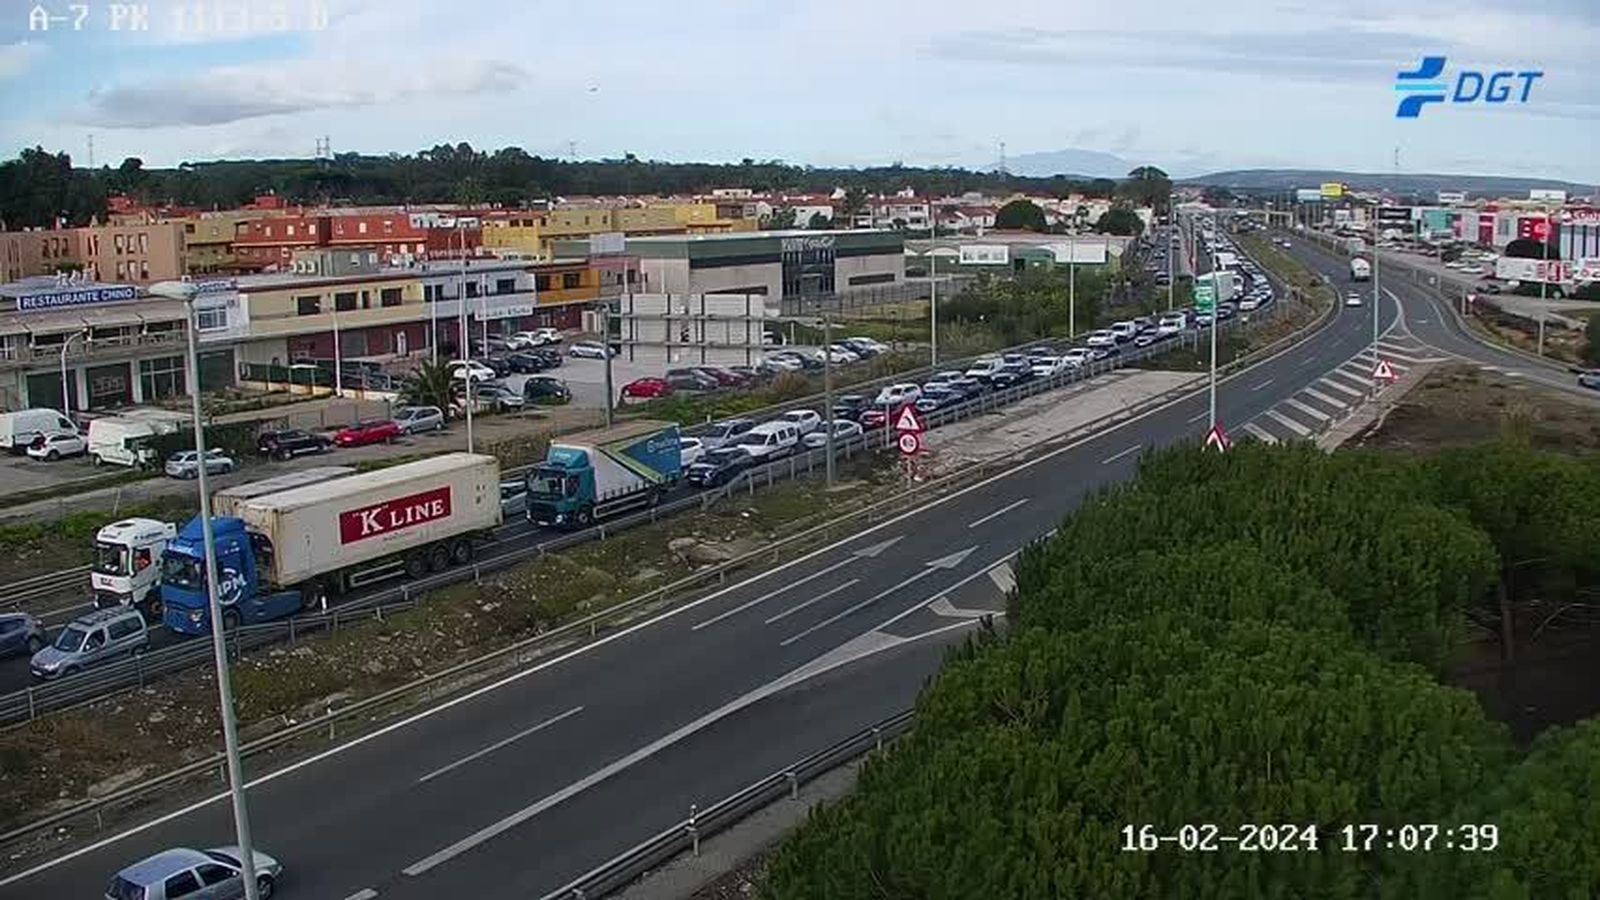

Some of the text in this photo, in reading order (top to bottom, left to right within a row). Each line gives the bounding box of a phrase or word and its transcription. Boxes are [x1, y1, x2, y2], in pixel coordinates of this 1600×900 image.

[23, 288, 134, 309] RESTAURANTE CHINO
[390, 499, 445, 527] LINE
